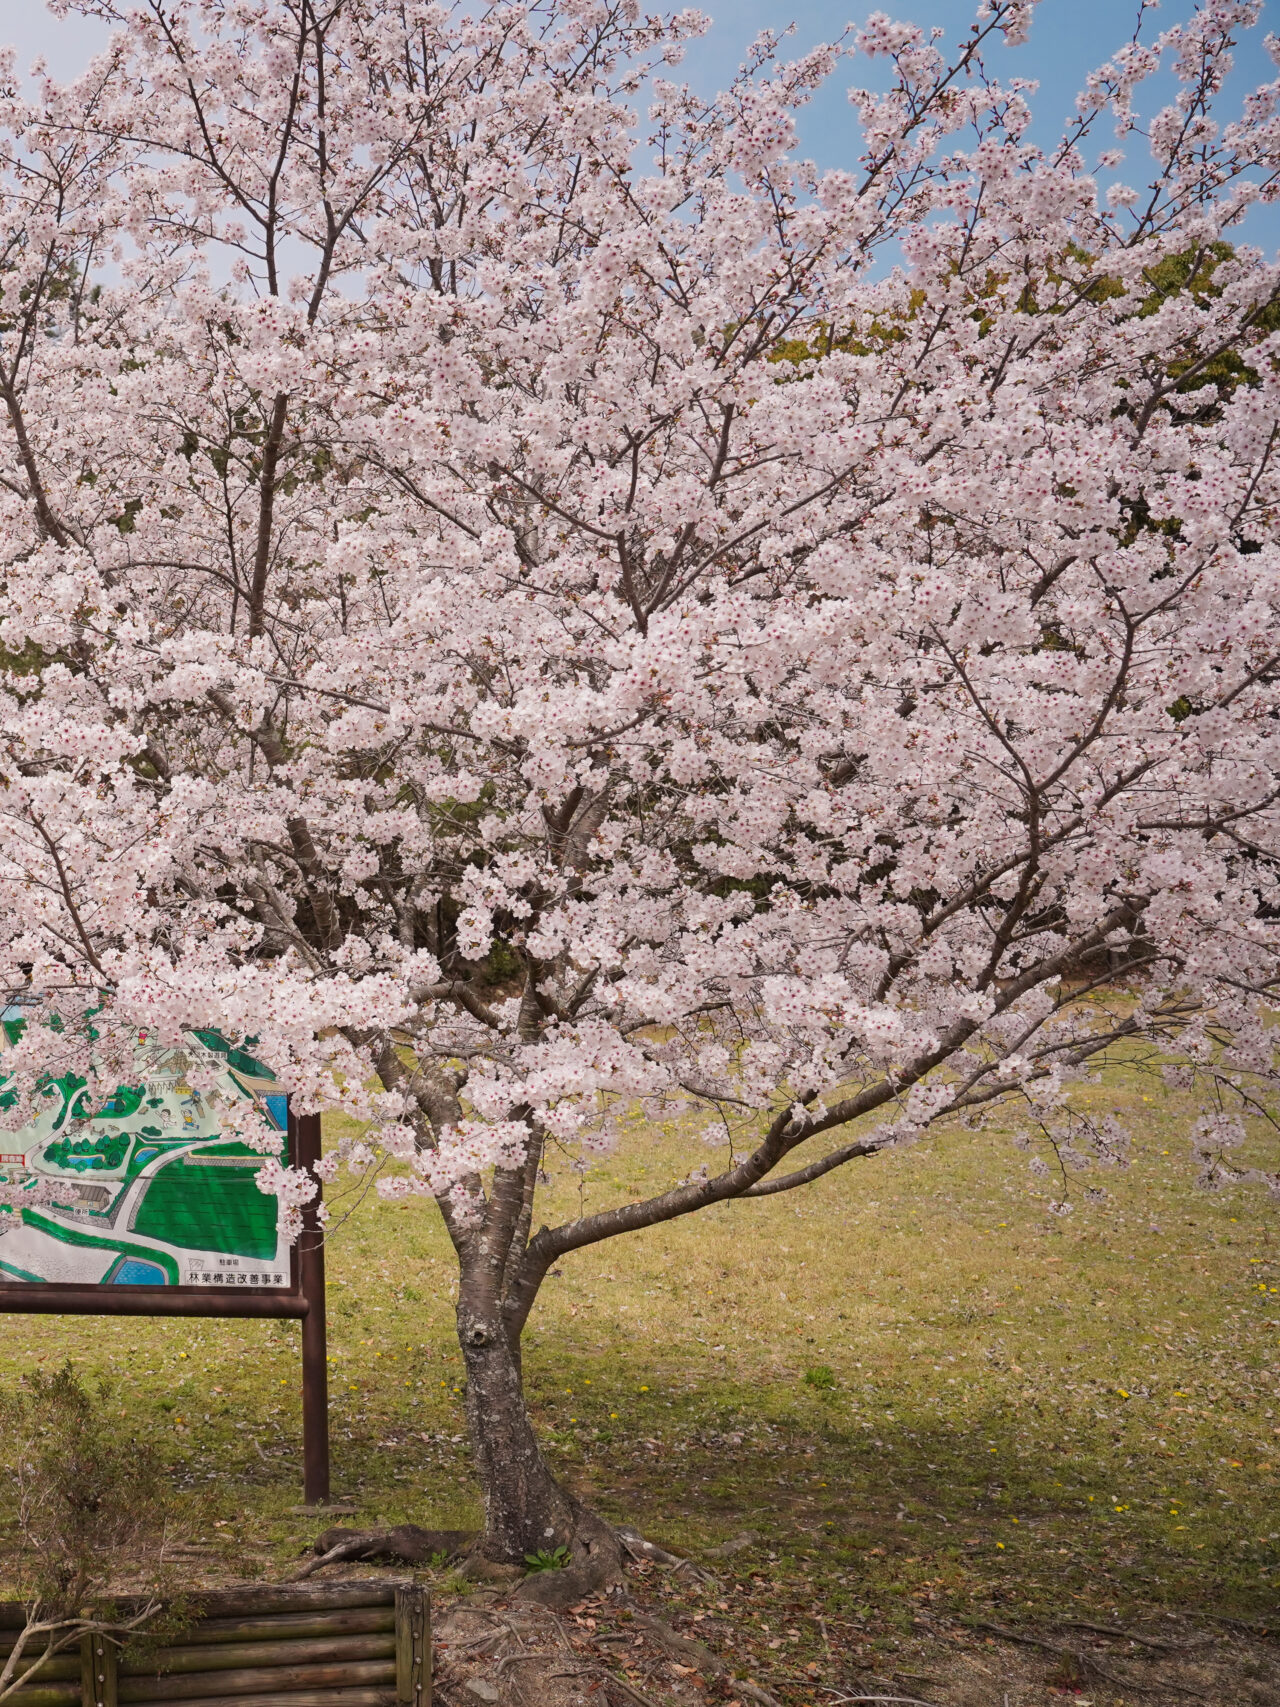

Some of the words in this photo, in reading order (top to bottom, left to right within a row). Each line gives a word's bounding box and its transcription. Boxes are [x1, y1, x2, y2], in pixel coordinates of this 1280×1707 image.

[188, 1272, 283, 1285] 林業構造改善事業
